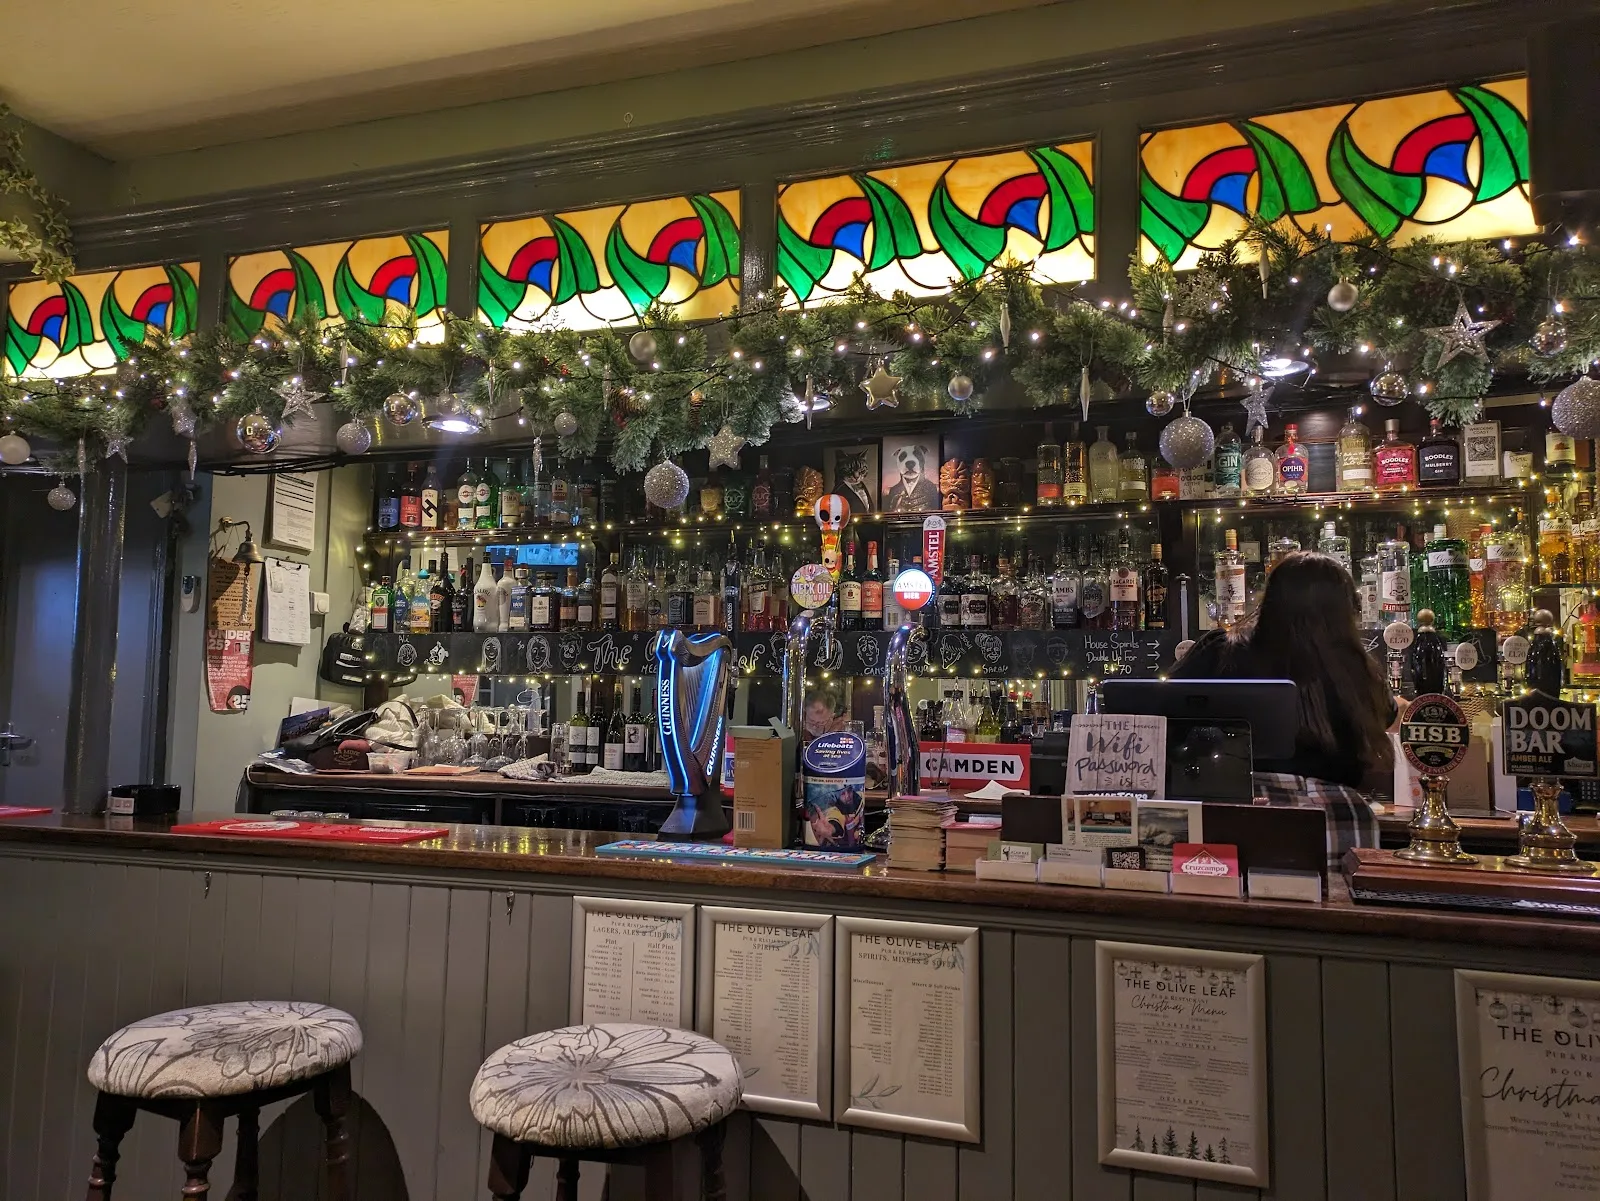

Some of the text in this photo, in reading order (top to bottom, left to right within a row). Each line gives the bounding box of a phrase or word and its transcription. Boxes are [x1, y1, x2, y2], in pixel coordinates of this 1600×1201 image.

[1220, 456, 1238, 467] GIN
[928, 532, 940, 578] AMSTEL
[792, 582, 830, 594] NECK OIL
[904, 592, 920, 600] BIER
[208, 630, 250, 640] UNDER
[208, 640, 230, 650] 25?
[1084, 632, 1140, 654] House Spirits
[587, 634, 632, 673] The
[1086, 652, 1138, 667] Double Up For
[234, 694, 250, 708] 25
[660, 678, 672, 736] GUINNESS
[1105, 720, 1130, 730] THE
[1510, 706, 1592, 731] DOOM
[1408, 725, 1460, 742] HSB
[706, 716, 723, 776] GUINNESS
[1086, 732, 1150, 760] Wifi
[1510, 730, 1566, 754] BAR
[1510, 754, 1536, 762] AMBER
[926, 758, 1014, 774] CAMDEN
[1075, 758, 1157, 780] Password
[1120, 776, 1132, 788] is
[1185, 864, 1226, 874] Cruzcampo
[616, 912, 649, 920] OLIVE
[592, 926, 620, 934] LAGERS,
[722, 922, 813, 938] THE OLIVE LEAF
[752, 943, 780, 952] SPIRITS
[858, 934, 958, 952] THE OLIVE LEAF
[858, 953, 890, 962] SPIRITS,
[892, 956, 920, 965] MIXERS
[1124, 978, 1236, 998] THE OLIVE LEAF
[1131, 994, 1228, 1016] Christmas Menu
[1156, 1022, 1202, 1030] STARTERS
[1498, 1025, 1543, 1044] THE
[1175, 1041, 1218, 1051] COURSES
[1550, 1068, 1592, 1078] BOOK
